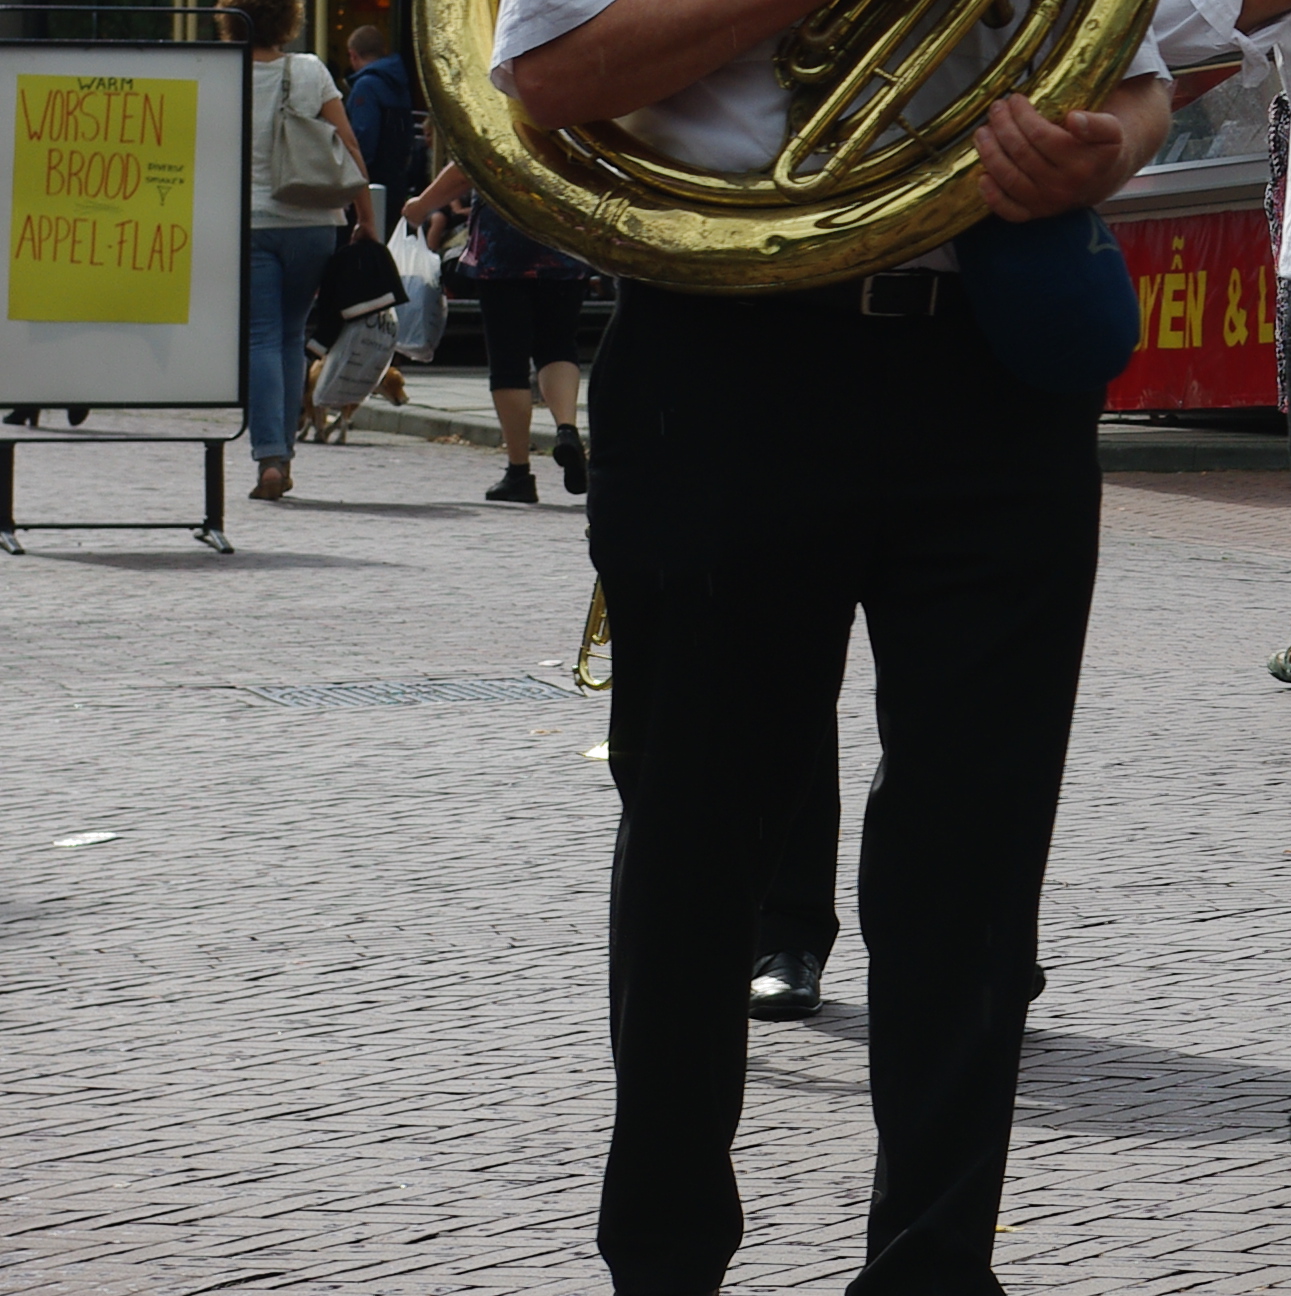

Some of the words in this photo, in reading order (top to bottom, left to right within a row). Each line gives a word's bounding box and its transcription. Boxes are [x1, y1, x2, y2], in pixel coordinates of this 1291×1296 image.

[77, 76, 134, 92] WARM
[20, 88, 165, 147] WORSTEN
[45, 147, 142, 201] BROOD
[1133, 235, 1208, 352] YỄN
[1222, 267, 1249, 348] &
